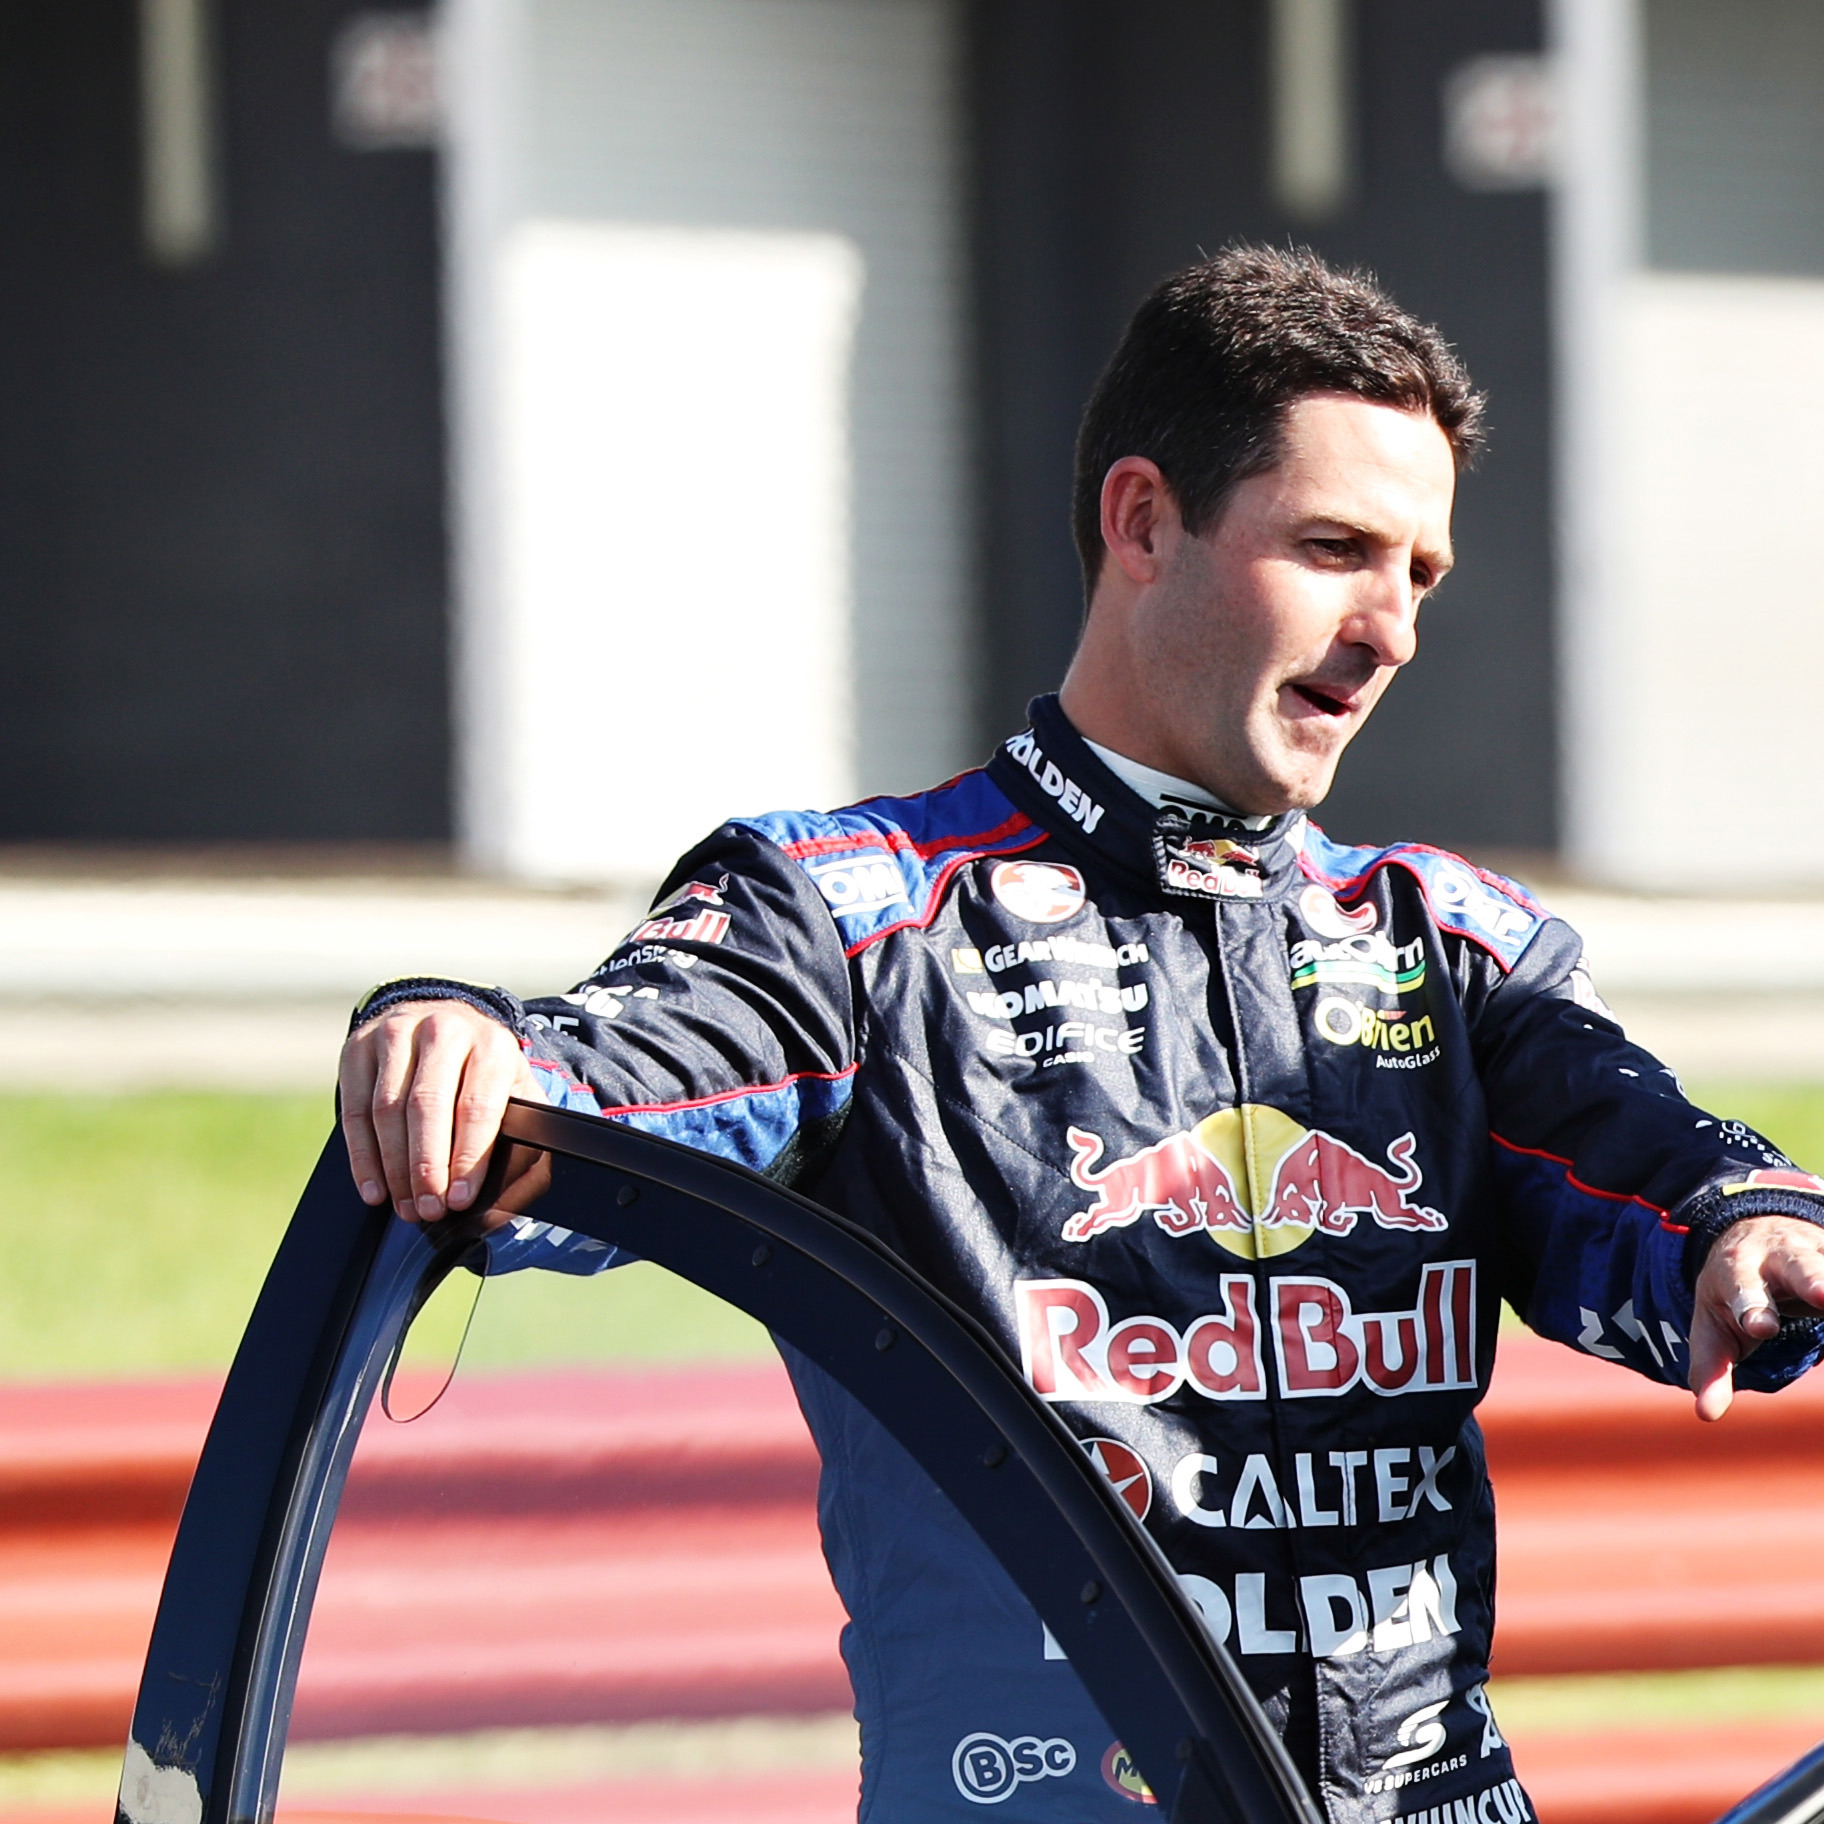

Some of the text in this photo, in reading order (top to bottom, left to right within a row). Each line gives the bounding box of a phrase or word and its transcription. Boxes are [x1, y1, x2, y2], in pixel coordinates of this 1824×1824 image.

[1168, 860, 1220, 894] Red
[986, 1022, 1146, 1057] EDIFICE
[1314, 997, 1436, 1051] O'Brien
[1043, 1052, 1095, 1067] CASIO
[1376, 1045, 1441, 1069] AutoGlass
[1016, 1259, 1477, 1403] Red Bull
[1172, 1446, 1457, 1529] CALTEX
[958, 1737, 1074, 1798] BSC
[1384, 1754, 1468, 1791] SUPERCARS
